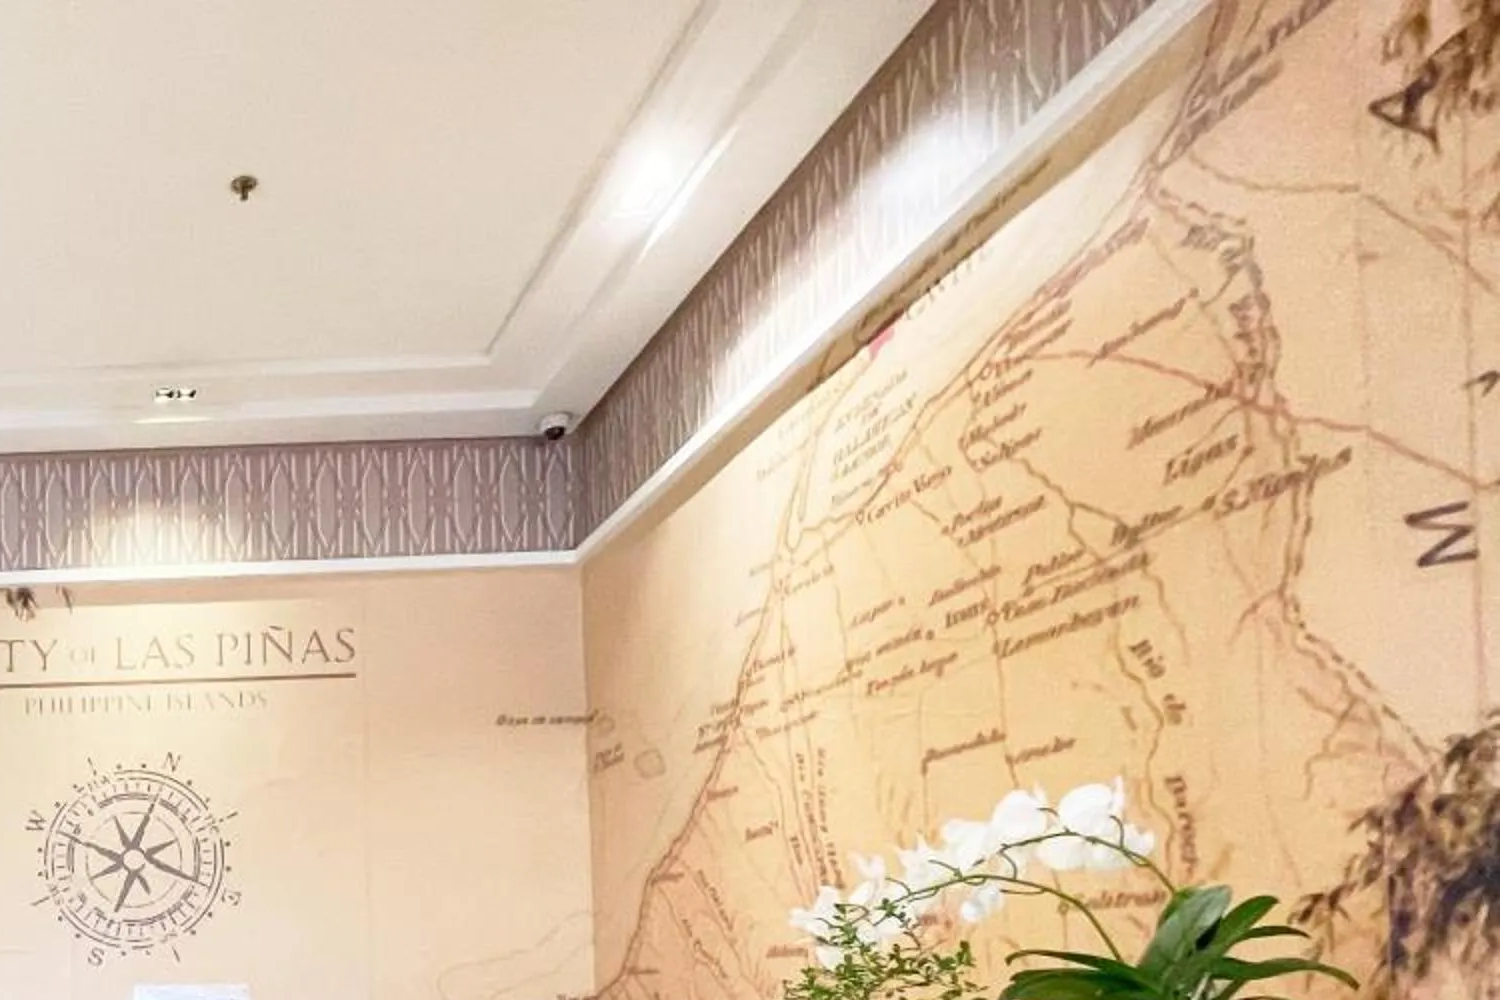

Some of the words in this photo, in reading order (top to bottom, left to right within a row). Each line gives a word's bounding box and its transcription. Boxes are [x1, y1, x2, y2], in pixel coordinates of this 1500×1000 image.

[115, 633, 196, 671] LAS
[216, 625, 357, 667] PIÑAS
[166, 690, 269, 712] ISLANDS
